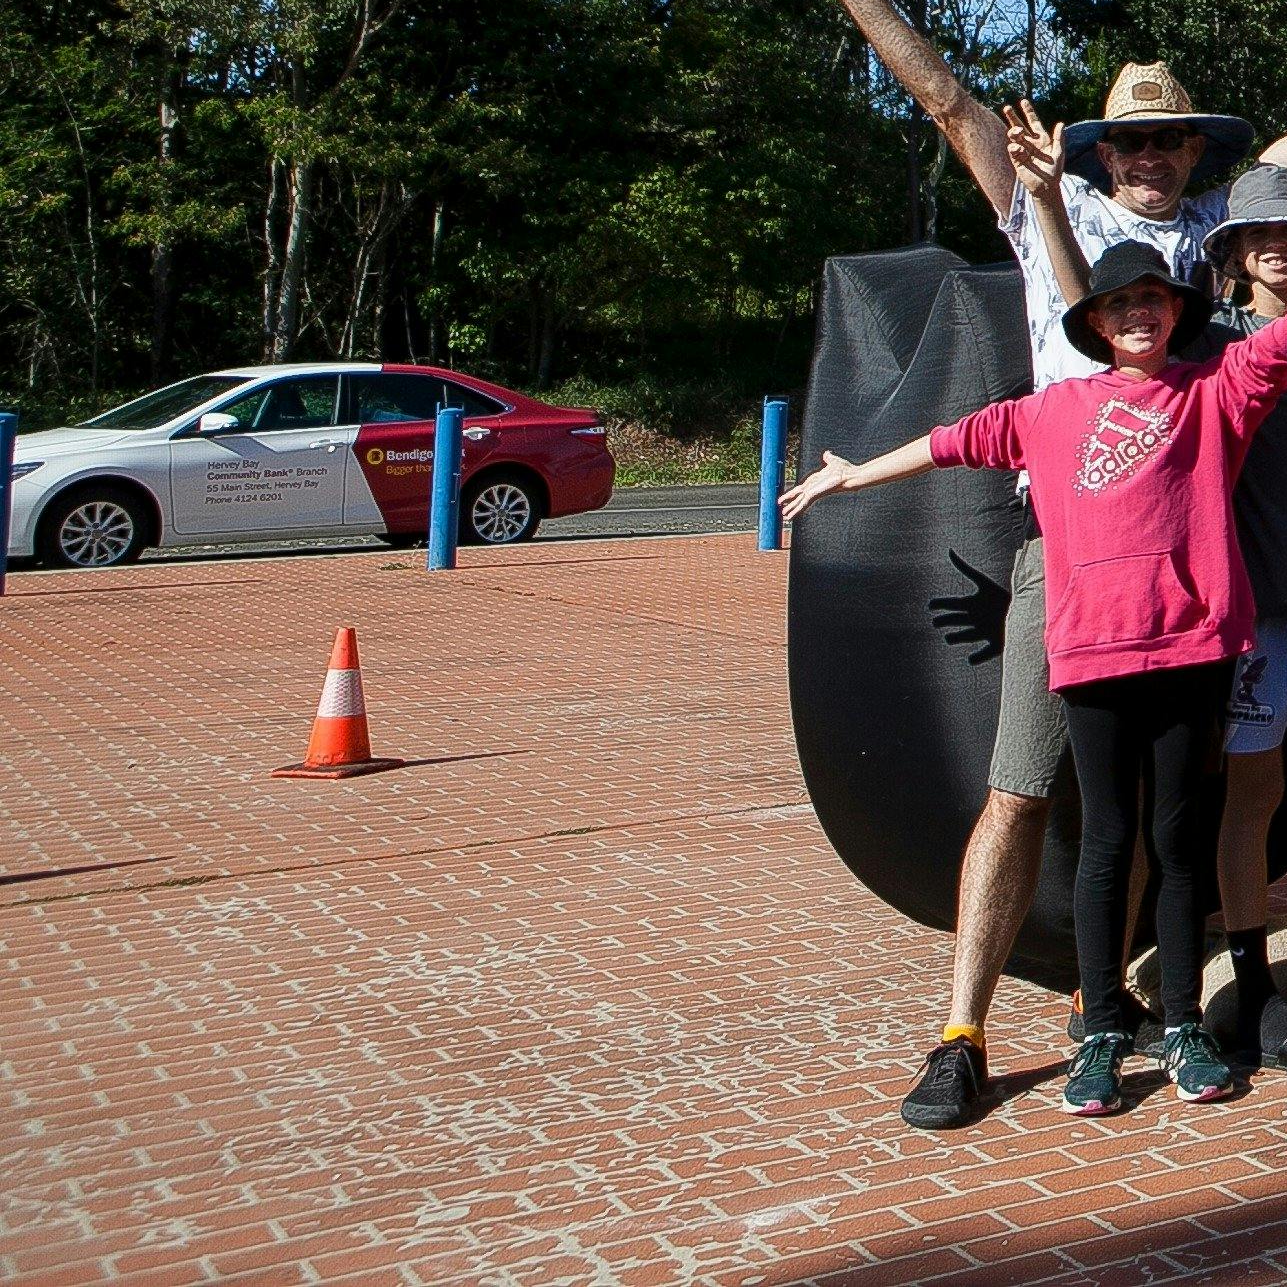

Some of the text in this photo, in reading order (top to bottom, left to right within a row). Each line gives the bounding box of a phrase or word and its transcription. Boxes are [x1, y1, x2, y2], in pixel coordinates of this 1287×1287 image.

[386, 448, 434, 462] Bendigo
[1083, 417, 1173, 490] adidas
[207, 459, 260, 470] Hervey Bay
[206, 470, 262, 481] Community
[296, 467, 328, 476] Branch
[206, 484, 219, 493] 55
[221, 483, 242, 492] Main
[274, 481, 302, 489] Hervey
[304, 479, 319, 489] Bay
[204, 496, 232, 505] Phone
[234, 494, 258, 503] 4124
